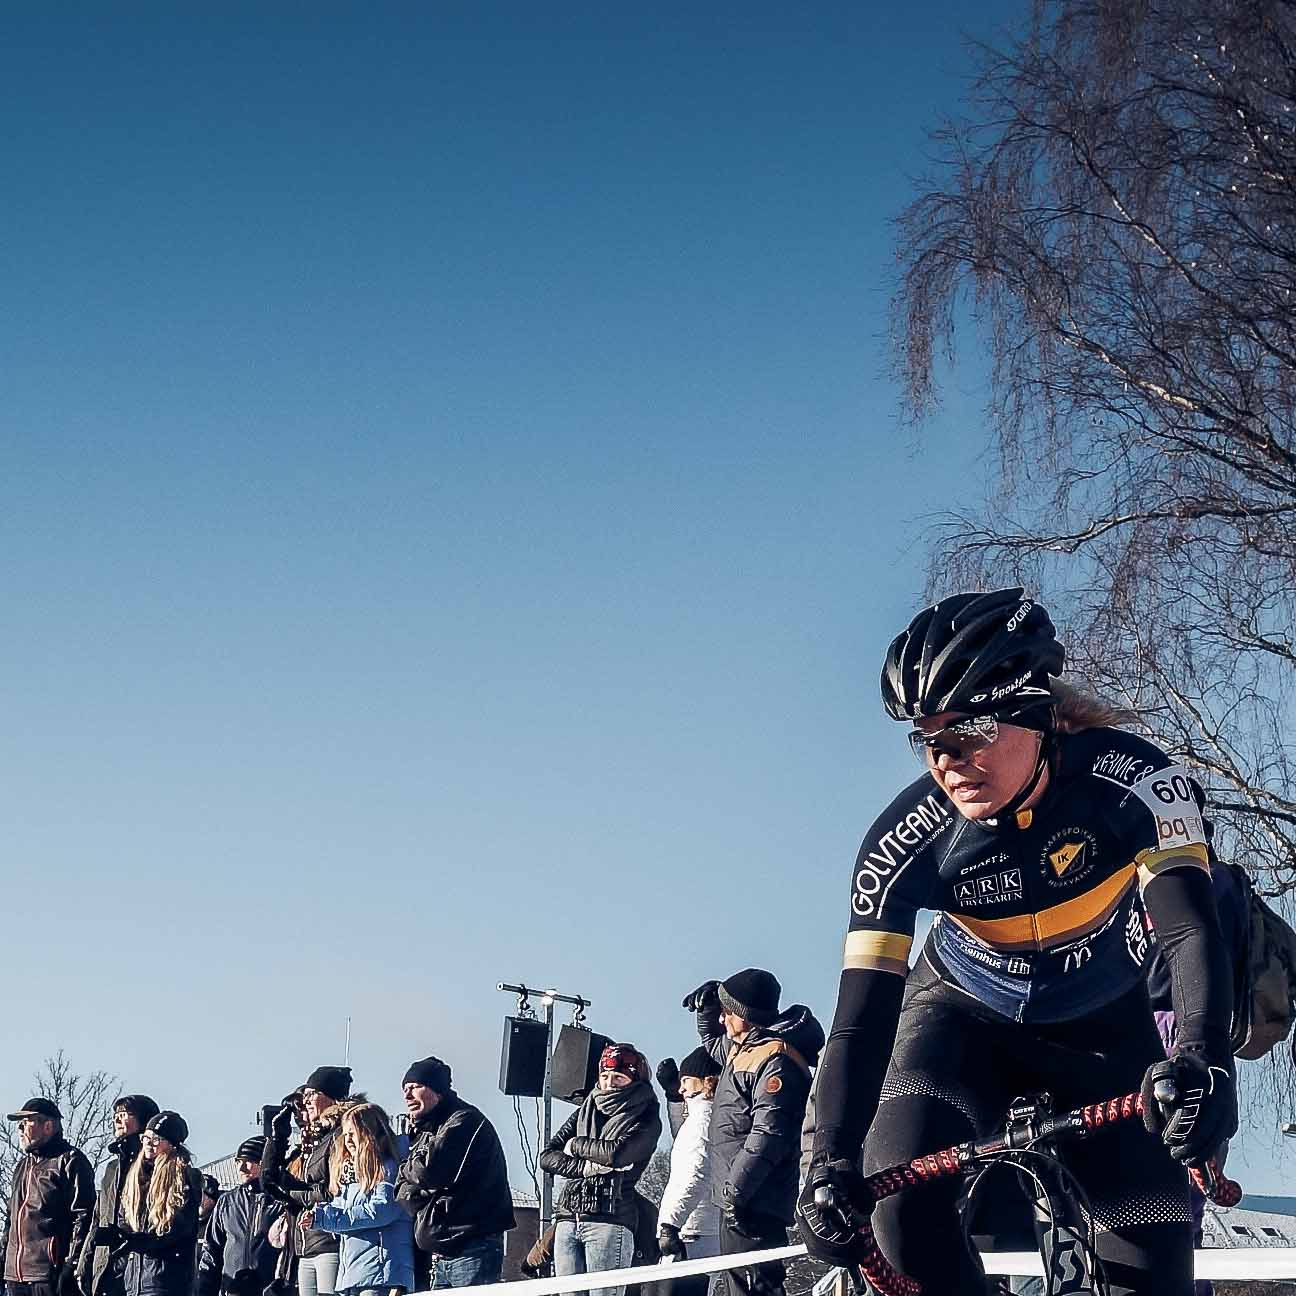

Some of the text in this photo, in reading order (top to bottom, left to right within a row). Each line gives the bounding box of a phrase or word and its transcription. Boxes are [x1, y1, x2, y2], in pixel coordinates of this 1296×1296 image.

[852, 794, 949, 916] GOLVTEAM
[1057, 852, 1070, 864] IK
[960, 871, 1018, 899] ARK
